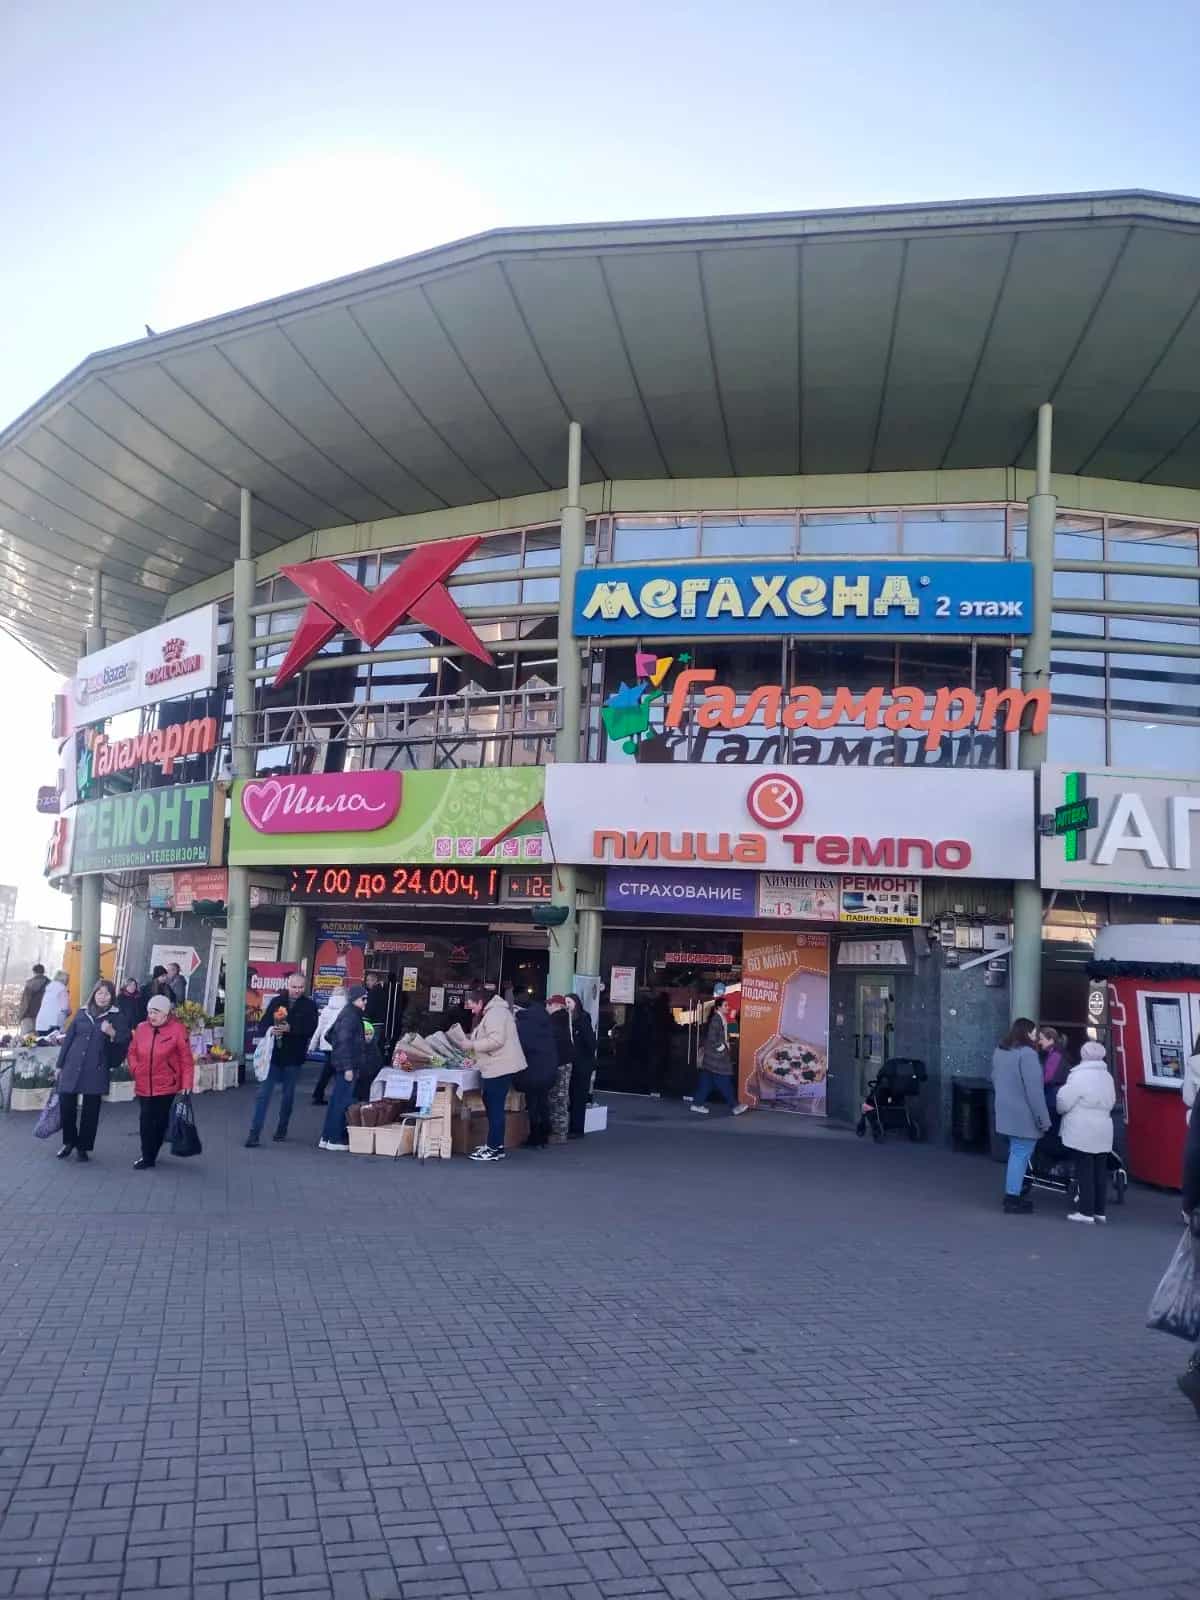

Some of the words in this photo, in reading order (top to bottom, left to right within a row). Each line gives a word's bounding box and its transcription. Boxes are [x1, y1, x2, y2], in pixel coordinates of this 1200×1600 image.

[935, 596, 951, 617] 2
[959, 598, 1023, 617] этаж
[665, 668, 1052, 751] Галамарт
[91, 716, 217, 778] Галамарт
[262, 780, 386, 822] Мила
[81, 784, 209, 851] РЕМОНТ
[150, 846, 206, 864] ТЕЛЕВИЗОРЫ
[306, 868, 351, 894] 7.00
[355, 873, 385, 899] до
[618, 881, 743, 901] СТРАХОВАНИЕ
[763, 875, 835, 890] ХИМЧИСТКА
[842, 876, 920, 893] РЕМОНТ
[774, 902, 793, 916] 13
[763, 949, 799, 970] МИНУТ
[250, 974, 290, 991] Соляри
[742, 986, 778, 1003] ПОДАРОК
